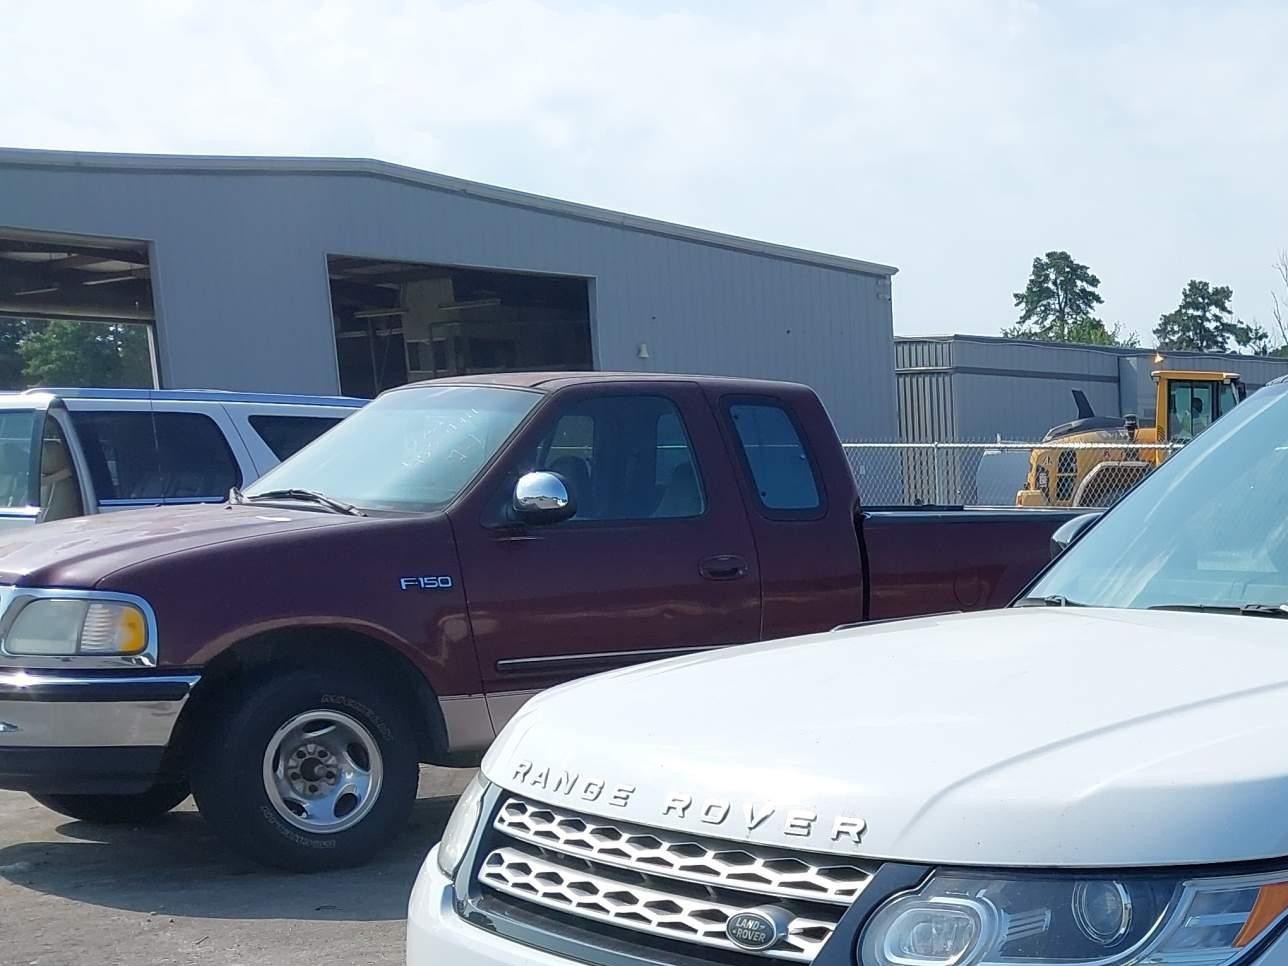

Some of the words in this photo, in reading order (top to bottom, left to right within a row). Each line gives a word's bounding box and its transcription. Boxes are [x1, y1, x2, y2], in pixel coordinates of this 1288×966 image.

[400, 576, 452, 590] F-150
[512, 760, 637, 808] RANGE
[662, 792, 868, 844] ROVER
